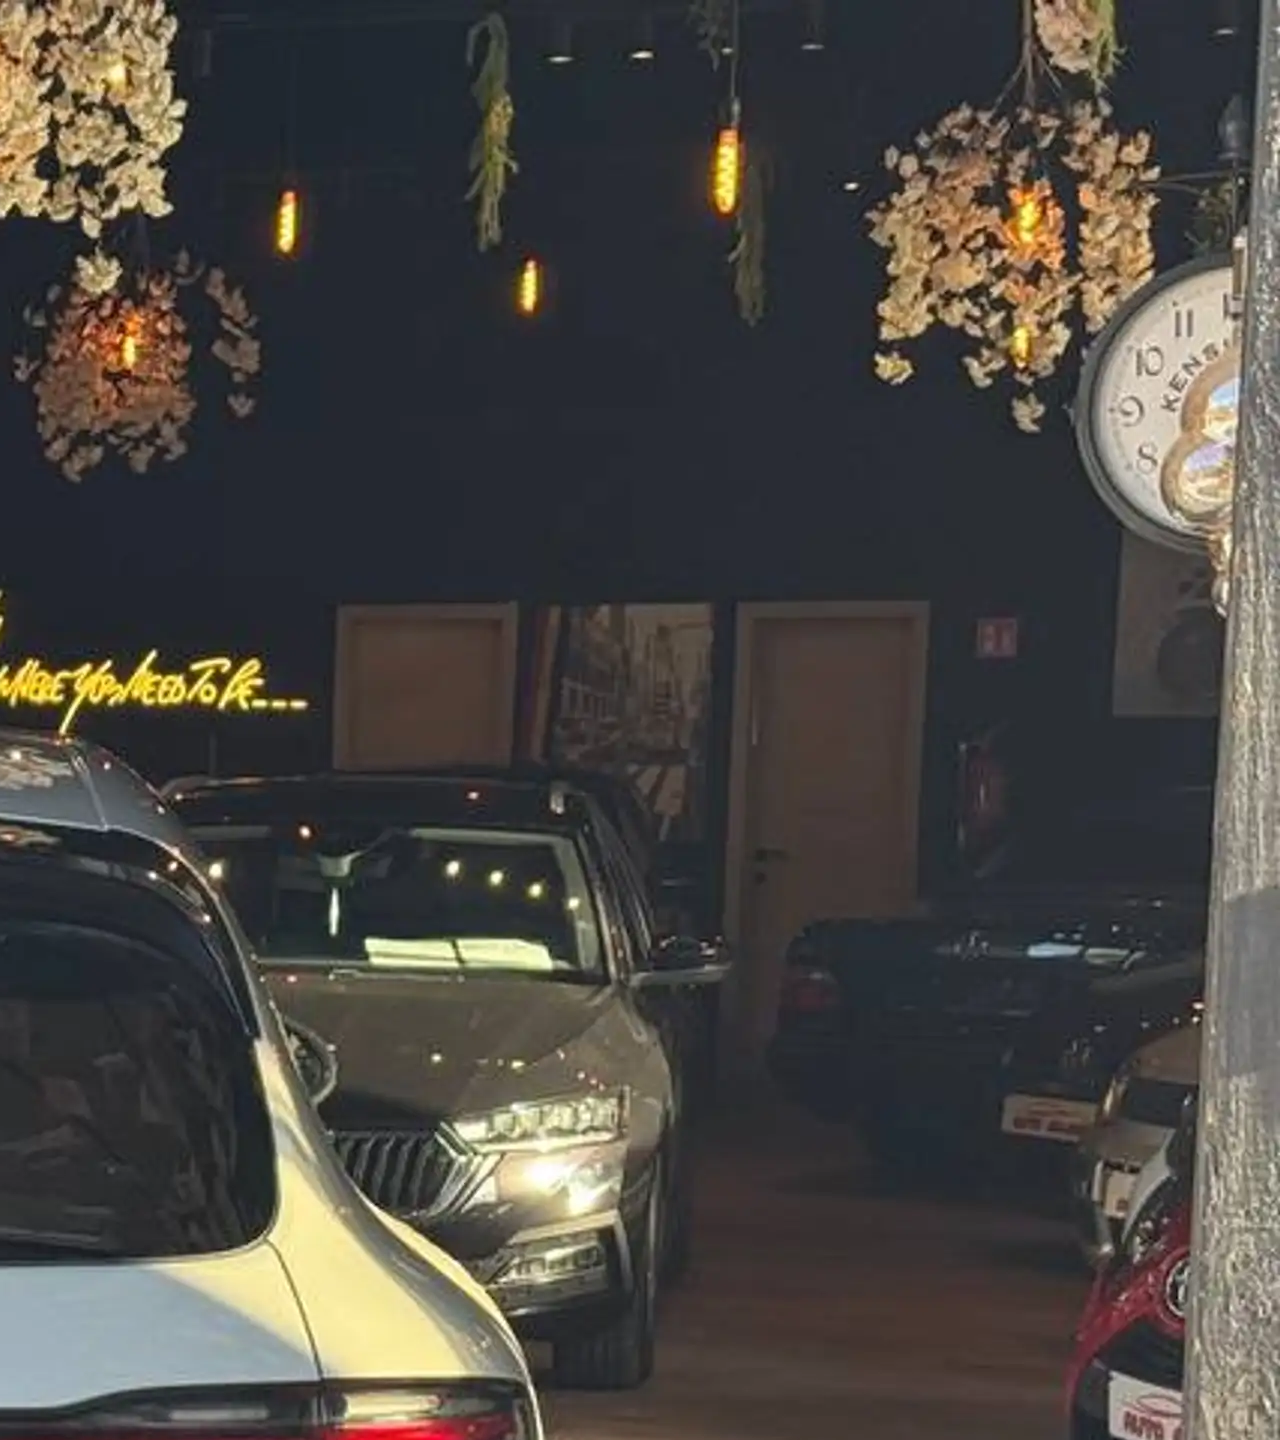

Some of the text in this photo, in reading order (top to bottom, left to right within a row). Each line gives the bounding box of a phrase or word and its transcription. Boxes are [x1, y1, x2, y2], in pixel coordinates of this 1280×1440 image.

[1136, 346, 1164, 378] 10
[1119, 395, 1143, 427] 9
[1136, 441, 1158, 475] 8
